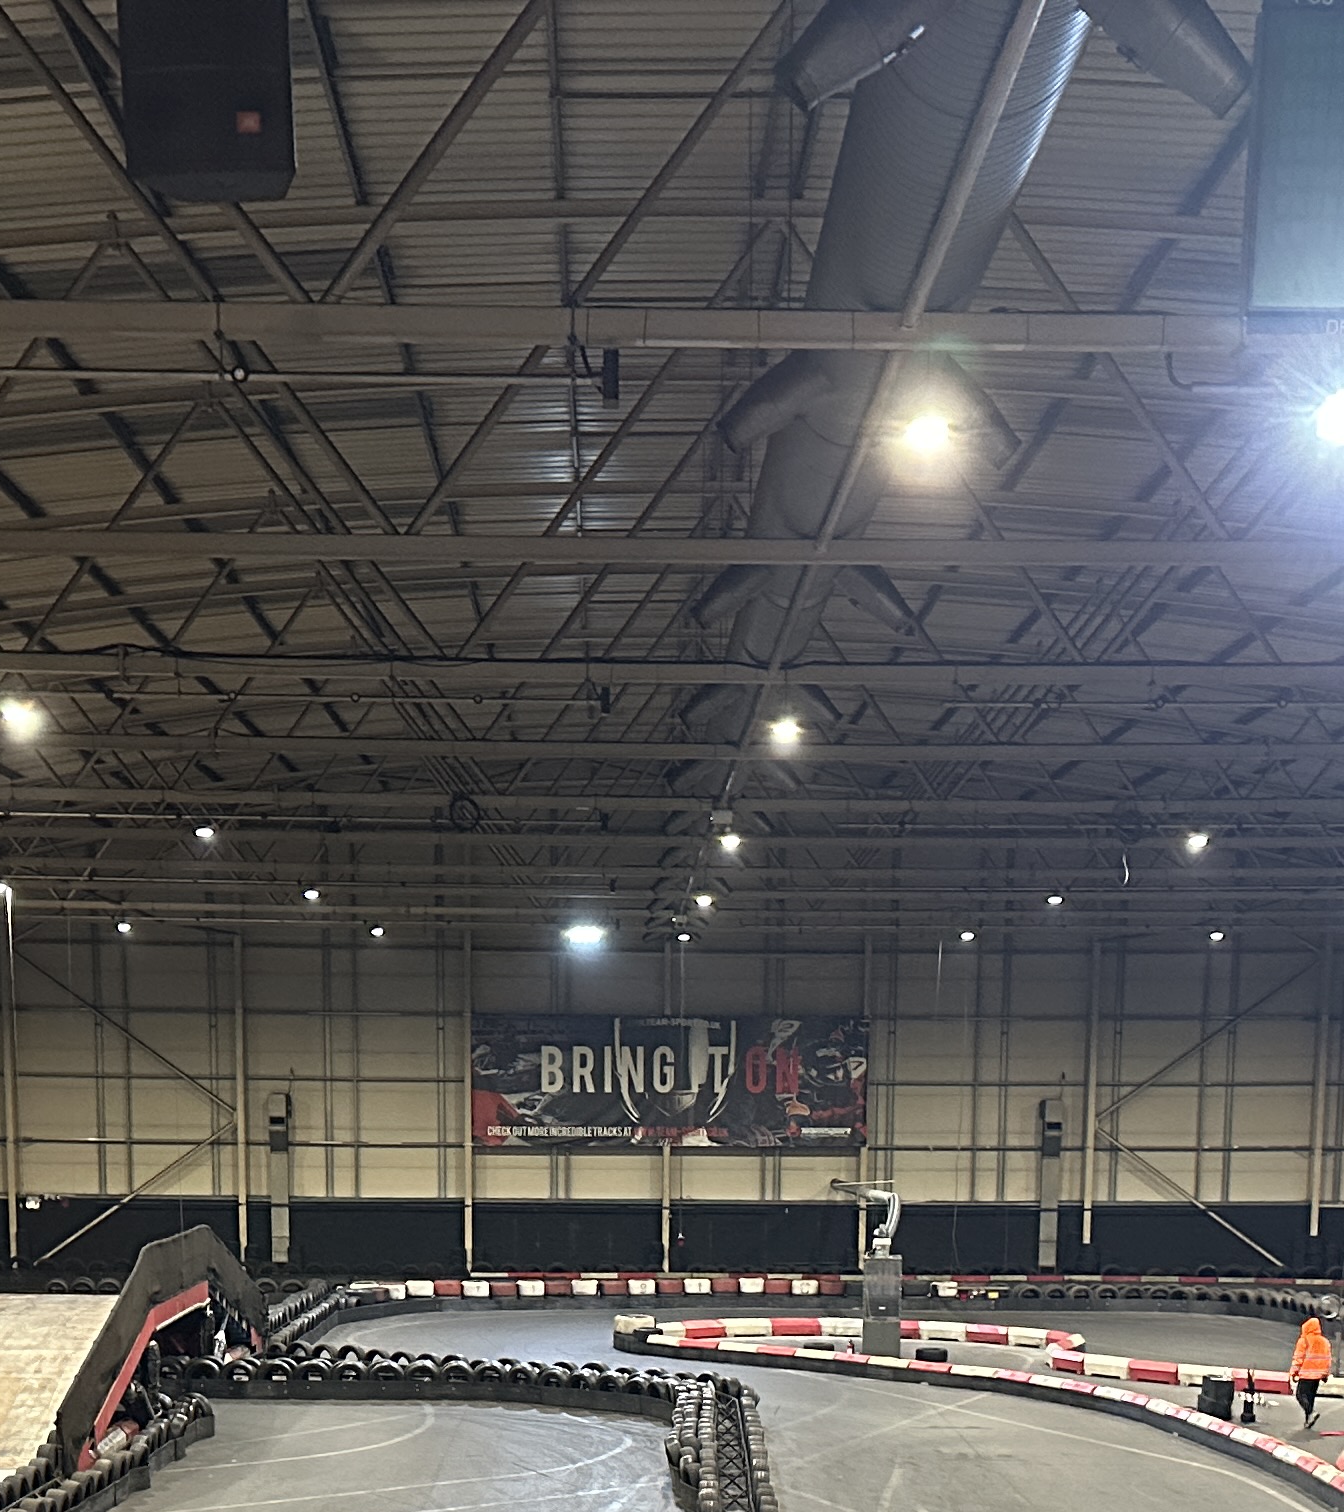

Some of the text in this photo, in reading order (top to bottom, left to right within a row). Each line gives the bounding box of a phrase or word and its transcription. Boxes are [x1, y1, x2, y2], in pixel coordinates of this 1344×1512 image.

[541, 1045, 675, 1093] BRING
[745, 1046, 800, 1093] ON
[487, 1126, 511, 1137] CHECK
[512, 1126, 527, 1137] OUT
[528, 1126, 549, 1137] MORE
[550, 1126, 592, 1137] INCREDIBLE
[593, 1126, 622, 1137] TRACKS
[623, 1126, 632, 1137] AT
